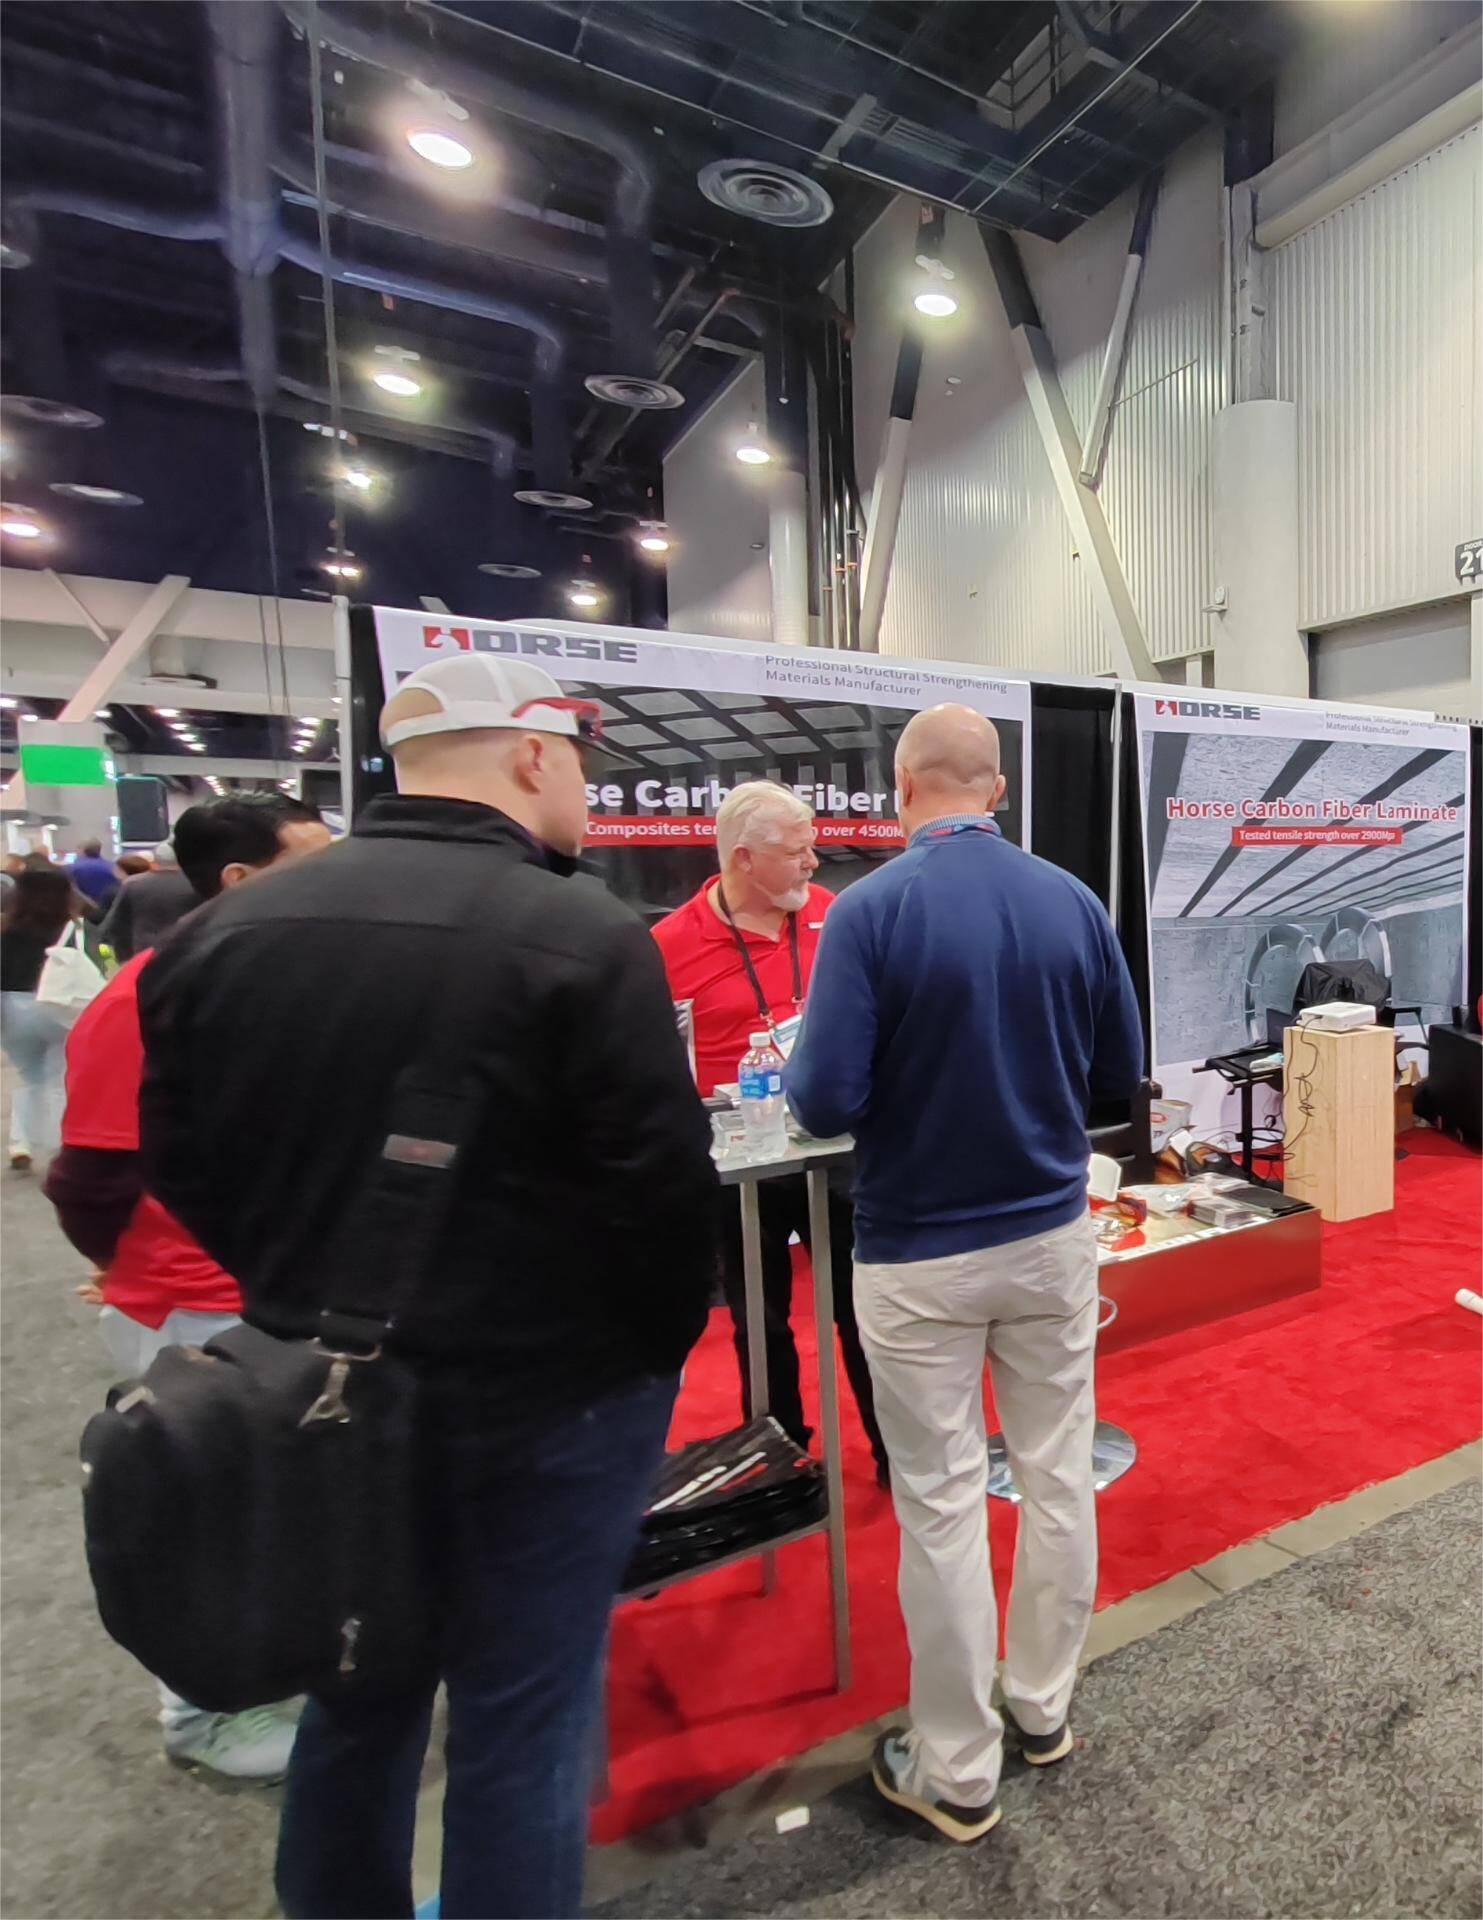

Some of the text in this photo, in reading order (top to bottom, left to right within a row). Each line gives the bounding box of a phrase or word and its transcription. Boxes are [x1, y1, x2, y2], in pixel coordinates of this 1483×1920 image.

[423, 626, 637, 663] HORSE
[765, 655, 1008, 694] Professional Structural Strengthening
[766, 670, 921, 696] Materials Manufacturer
[1155, 699, 1260, 720] HORSE
[635, 779, 730, 808] Carb
[793, 783, 887, 812] Fiber
[1167, 796, 1458, 822] Horse Carbon Fiber Laminate
[586, 821, 690, 838] Composites
[822, 826, 856, 837] over
[858, 824, 905, 838] 4500M
[1239, 829, 1271, 840] Tested
[1272, 829, 1303, 840] tensile
[1303, 830, 1340, 843] strength
[1340, 831, 1361, 841] over
